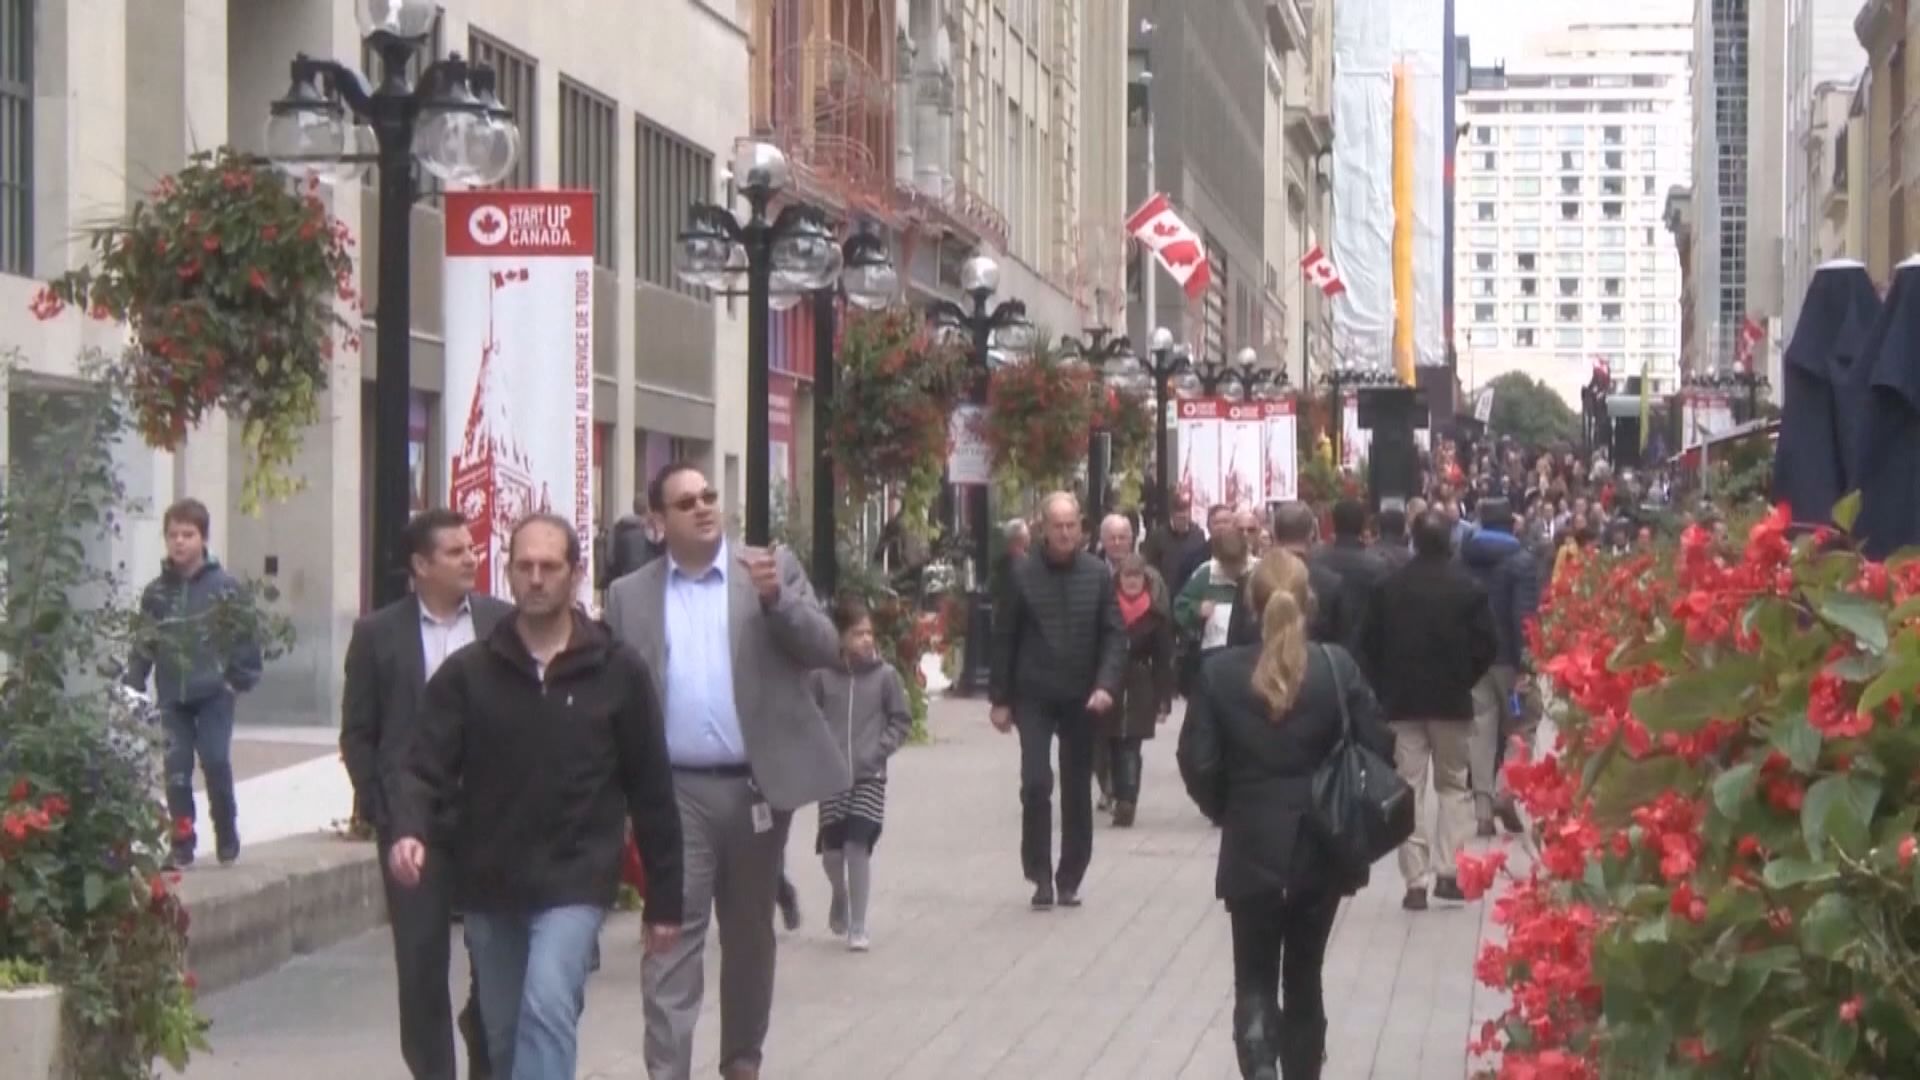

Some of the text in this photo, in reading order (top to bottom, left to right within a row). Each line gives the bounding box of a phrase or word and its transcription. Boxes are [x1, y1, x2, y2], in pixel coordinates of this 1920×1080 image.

[509, 204, 571, 228] START UP
[510, 228, 571, 246] CANADA
[575, 270, 588, 305] TOUS
[575, 311, 588, 329] DE
[575, 331, 588, 389] SERVICE
[575, 392, 588, 410] AU
